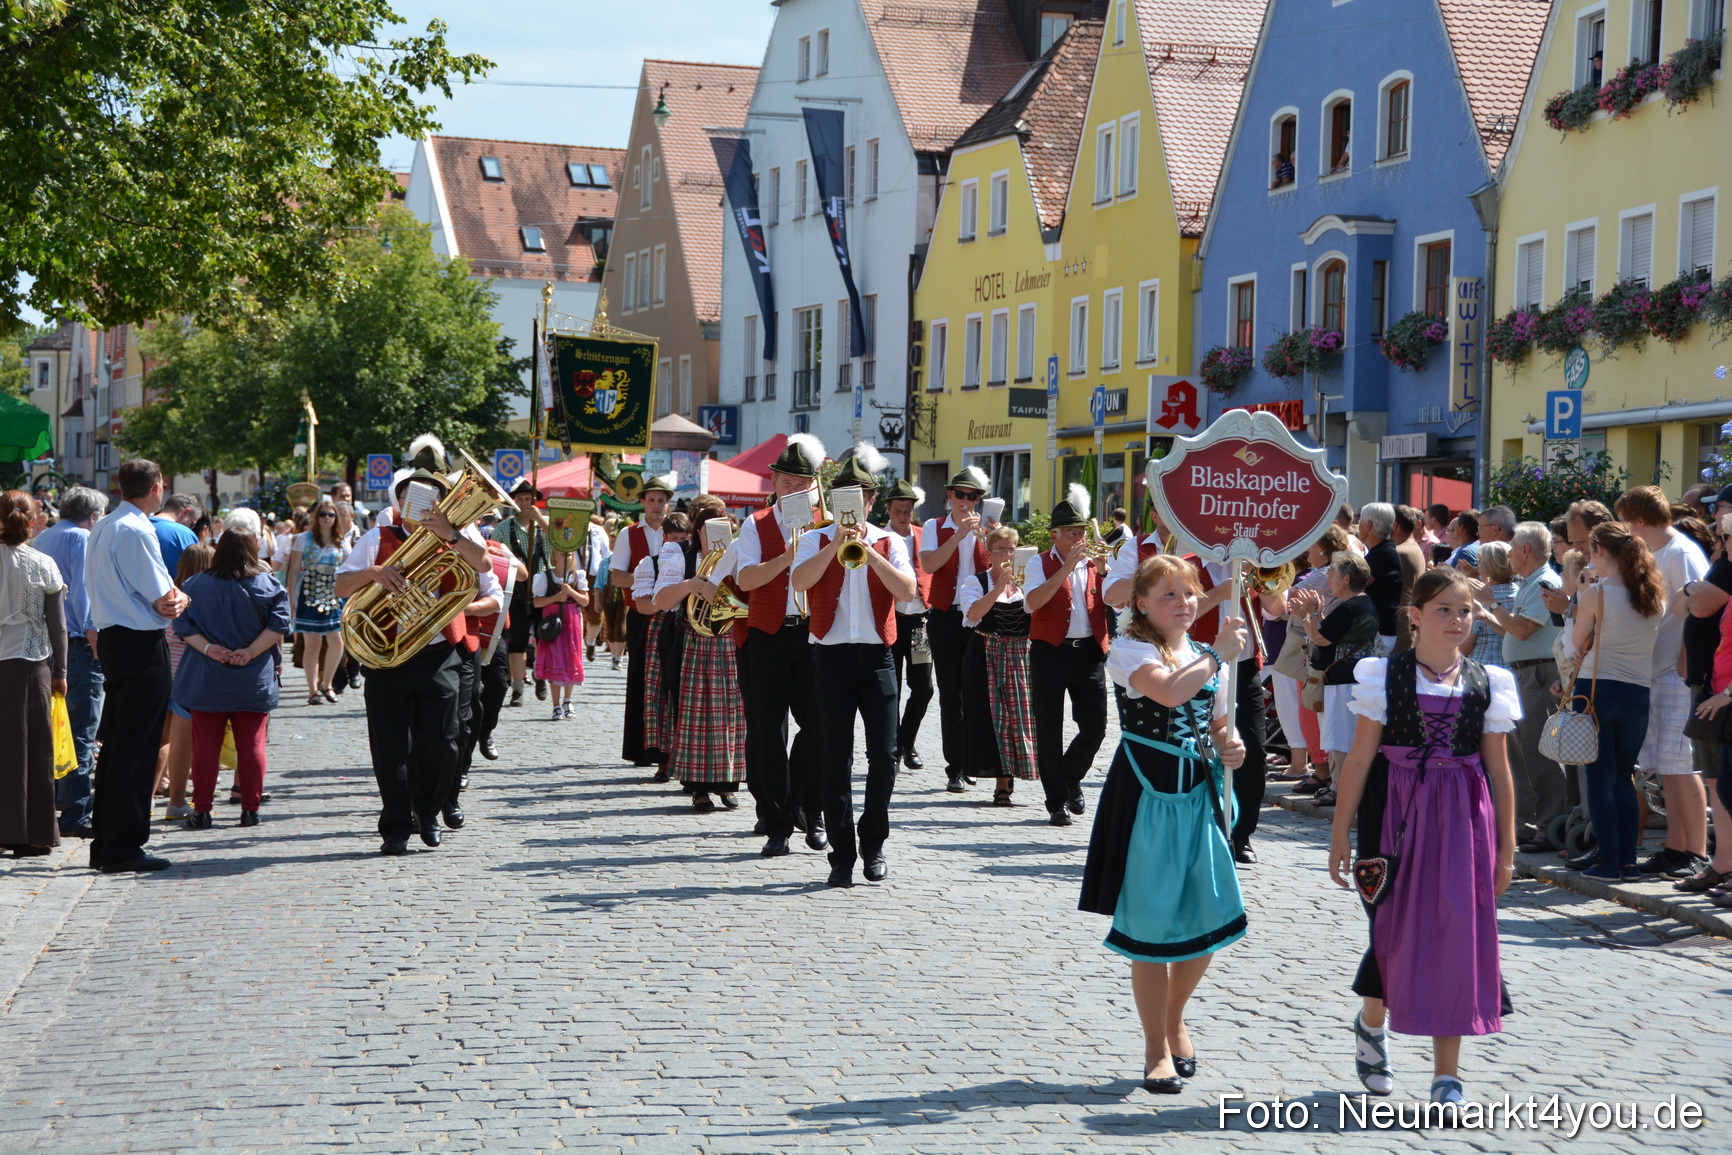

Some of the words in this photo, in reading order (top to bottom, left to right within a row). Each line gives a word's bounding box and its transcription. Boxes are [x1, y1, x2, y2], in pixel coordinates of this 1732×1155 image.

[975, 271, 1006, 303] HOTEL
[1014, 266, 1052, 294] Lehmeier
[1458, 280, 1480, 299] CAFÉ
[574, 348, 631, 366] Schützengau
[1458, 303, 1478, 400] WITTL
[1049, 361, 1057, 391] P
[1011, 406, 1048, 415] TAIFUN
[1096, 391, 1103, 422] P
[1553, 396, 1574, 434] P
[967, 420, 1013, 441] Restaurant
[370, 479, 390, 488] TAXI
[1190, 466, 1310, 496] Blaskapelle
[550, 500, 591, 509] SCHÜTZENGAU
[731, 494, 764, 502] Restaurant
[1199, 494, 1300, 520] Dirnhofer
[1233, 522, 1260, 538] Stauf
